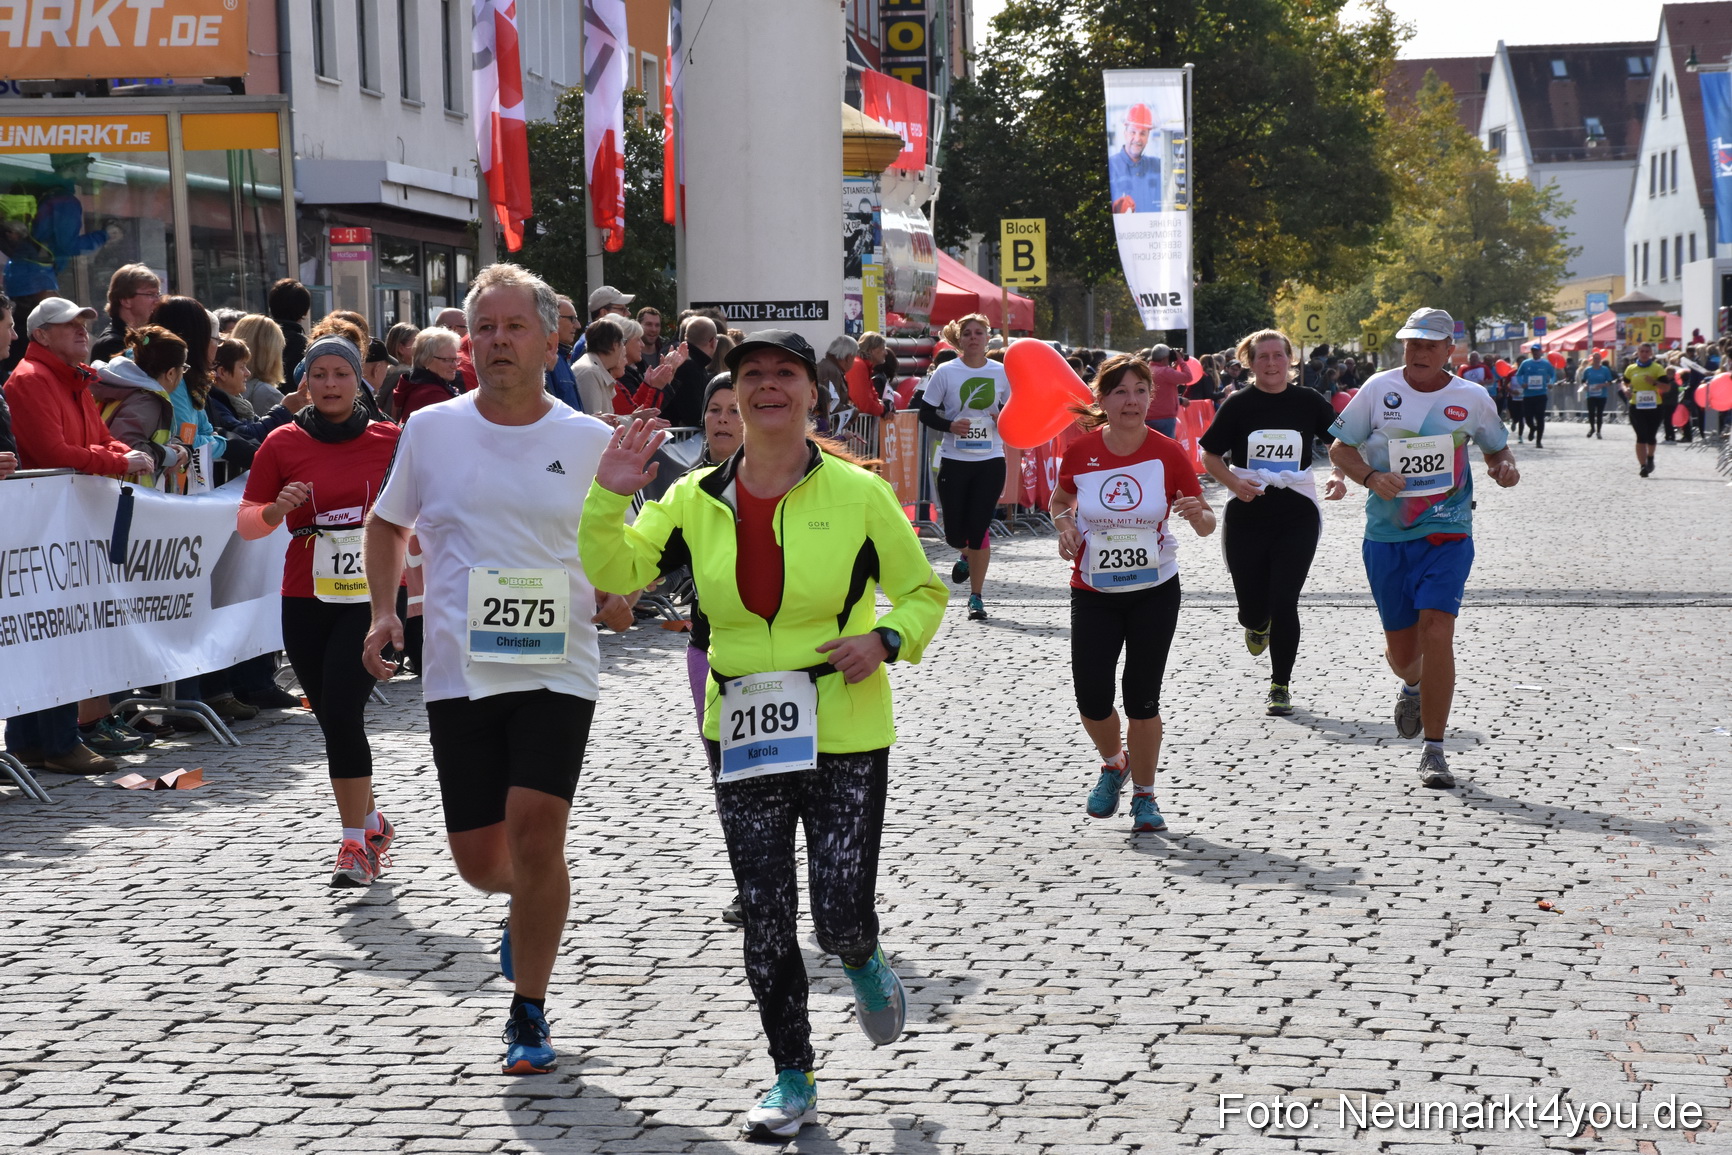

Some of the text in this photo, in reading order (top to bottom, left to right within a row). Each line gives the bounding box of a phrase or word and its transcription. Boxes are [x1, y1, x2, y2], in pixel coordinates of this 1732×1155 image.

[1006, 222, 1041, 235] Block
[1013, 239, 1036, 272] B
[1303, 304, 1324, 312] Block
[1306, 314, 1320, 333] C
[1651, 323, 1661, 338] D
[1367, 333, 1378, 347] D
[1255, 444, 1294, 459] 2744
[545, 467, 566, 475] adidas
[1399, 453, 1445, 475] 2382
[1412, 479, 1436, 487] Johann
[328, 512, 350, 522] DEHN
[1099, 547, 1149, 569] 2338
[508, 577, 544, 587] BOCK
[1112, 573, 1138, 582] Renate
[483, 597, 555, 628] 2575
[496, 636, 541, 648] Christian
[748, 680, 783, 693] BOCK
[730, 701, 799, 742] 2189
[747, 745, 779, 761] Karola
